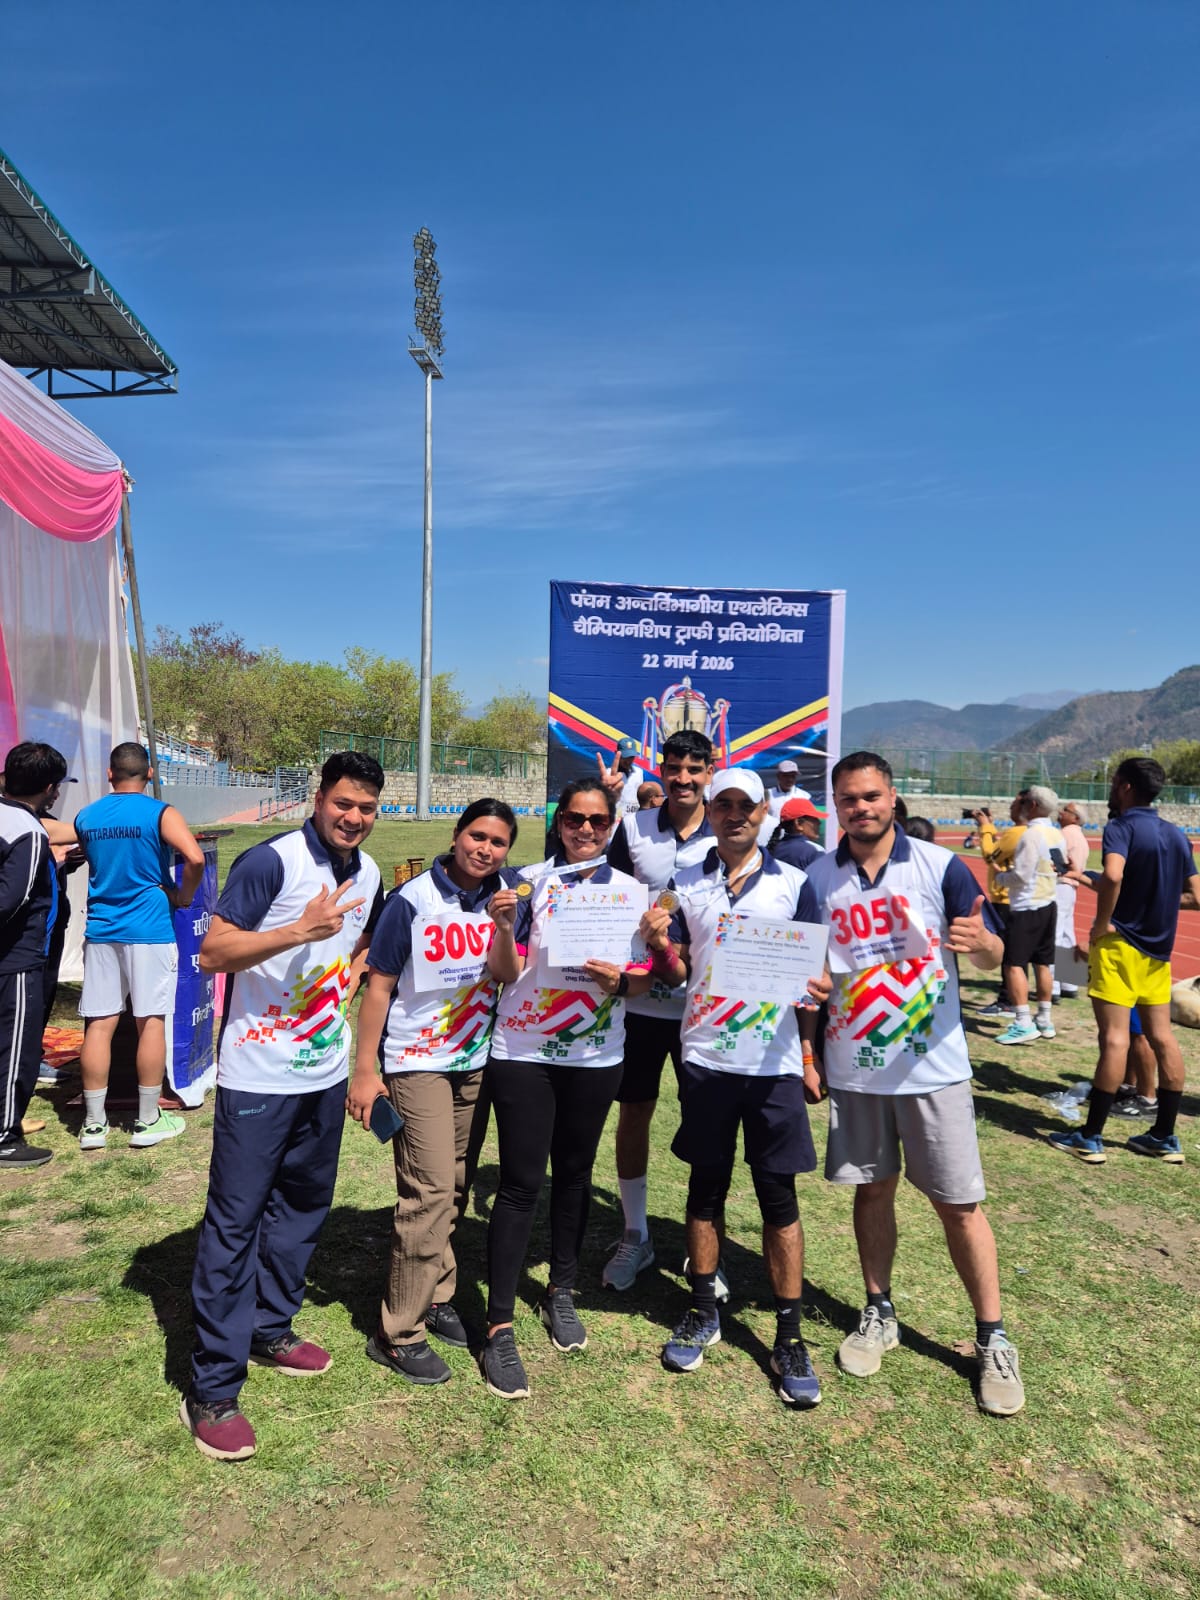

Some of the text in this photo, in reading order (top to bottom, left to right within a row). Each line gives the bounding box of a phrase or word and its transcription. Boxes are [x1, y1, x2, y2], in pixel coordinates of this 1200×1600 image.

[570, 588, 809, 617] पंचम अन्तर्विभागीय एथलेटिक्स
[573, 615, 805, 645] चैम्पियनशिप ट्राफी प्रतियोगिता
[642, 650, 735, 671] 22 मार्च 2026
[831, 895, 910, 945] 3059
